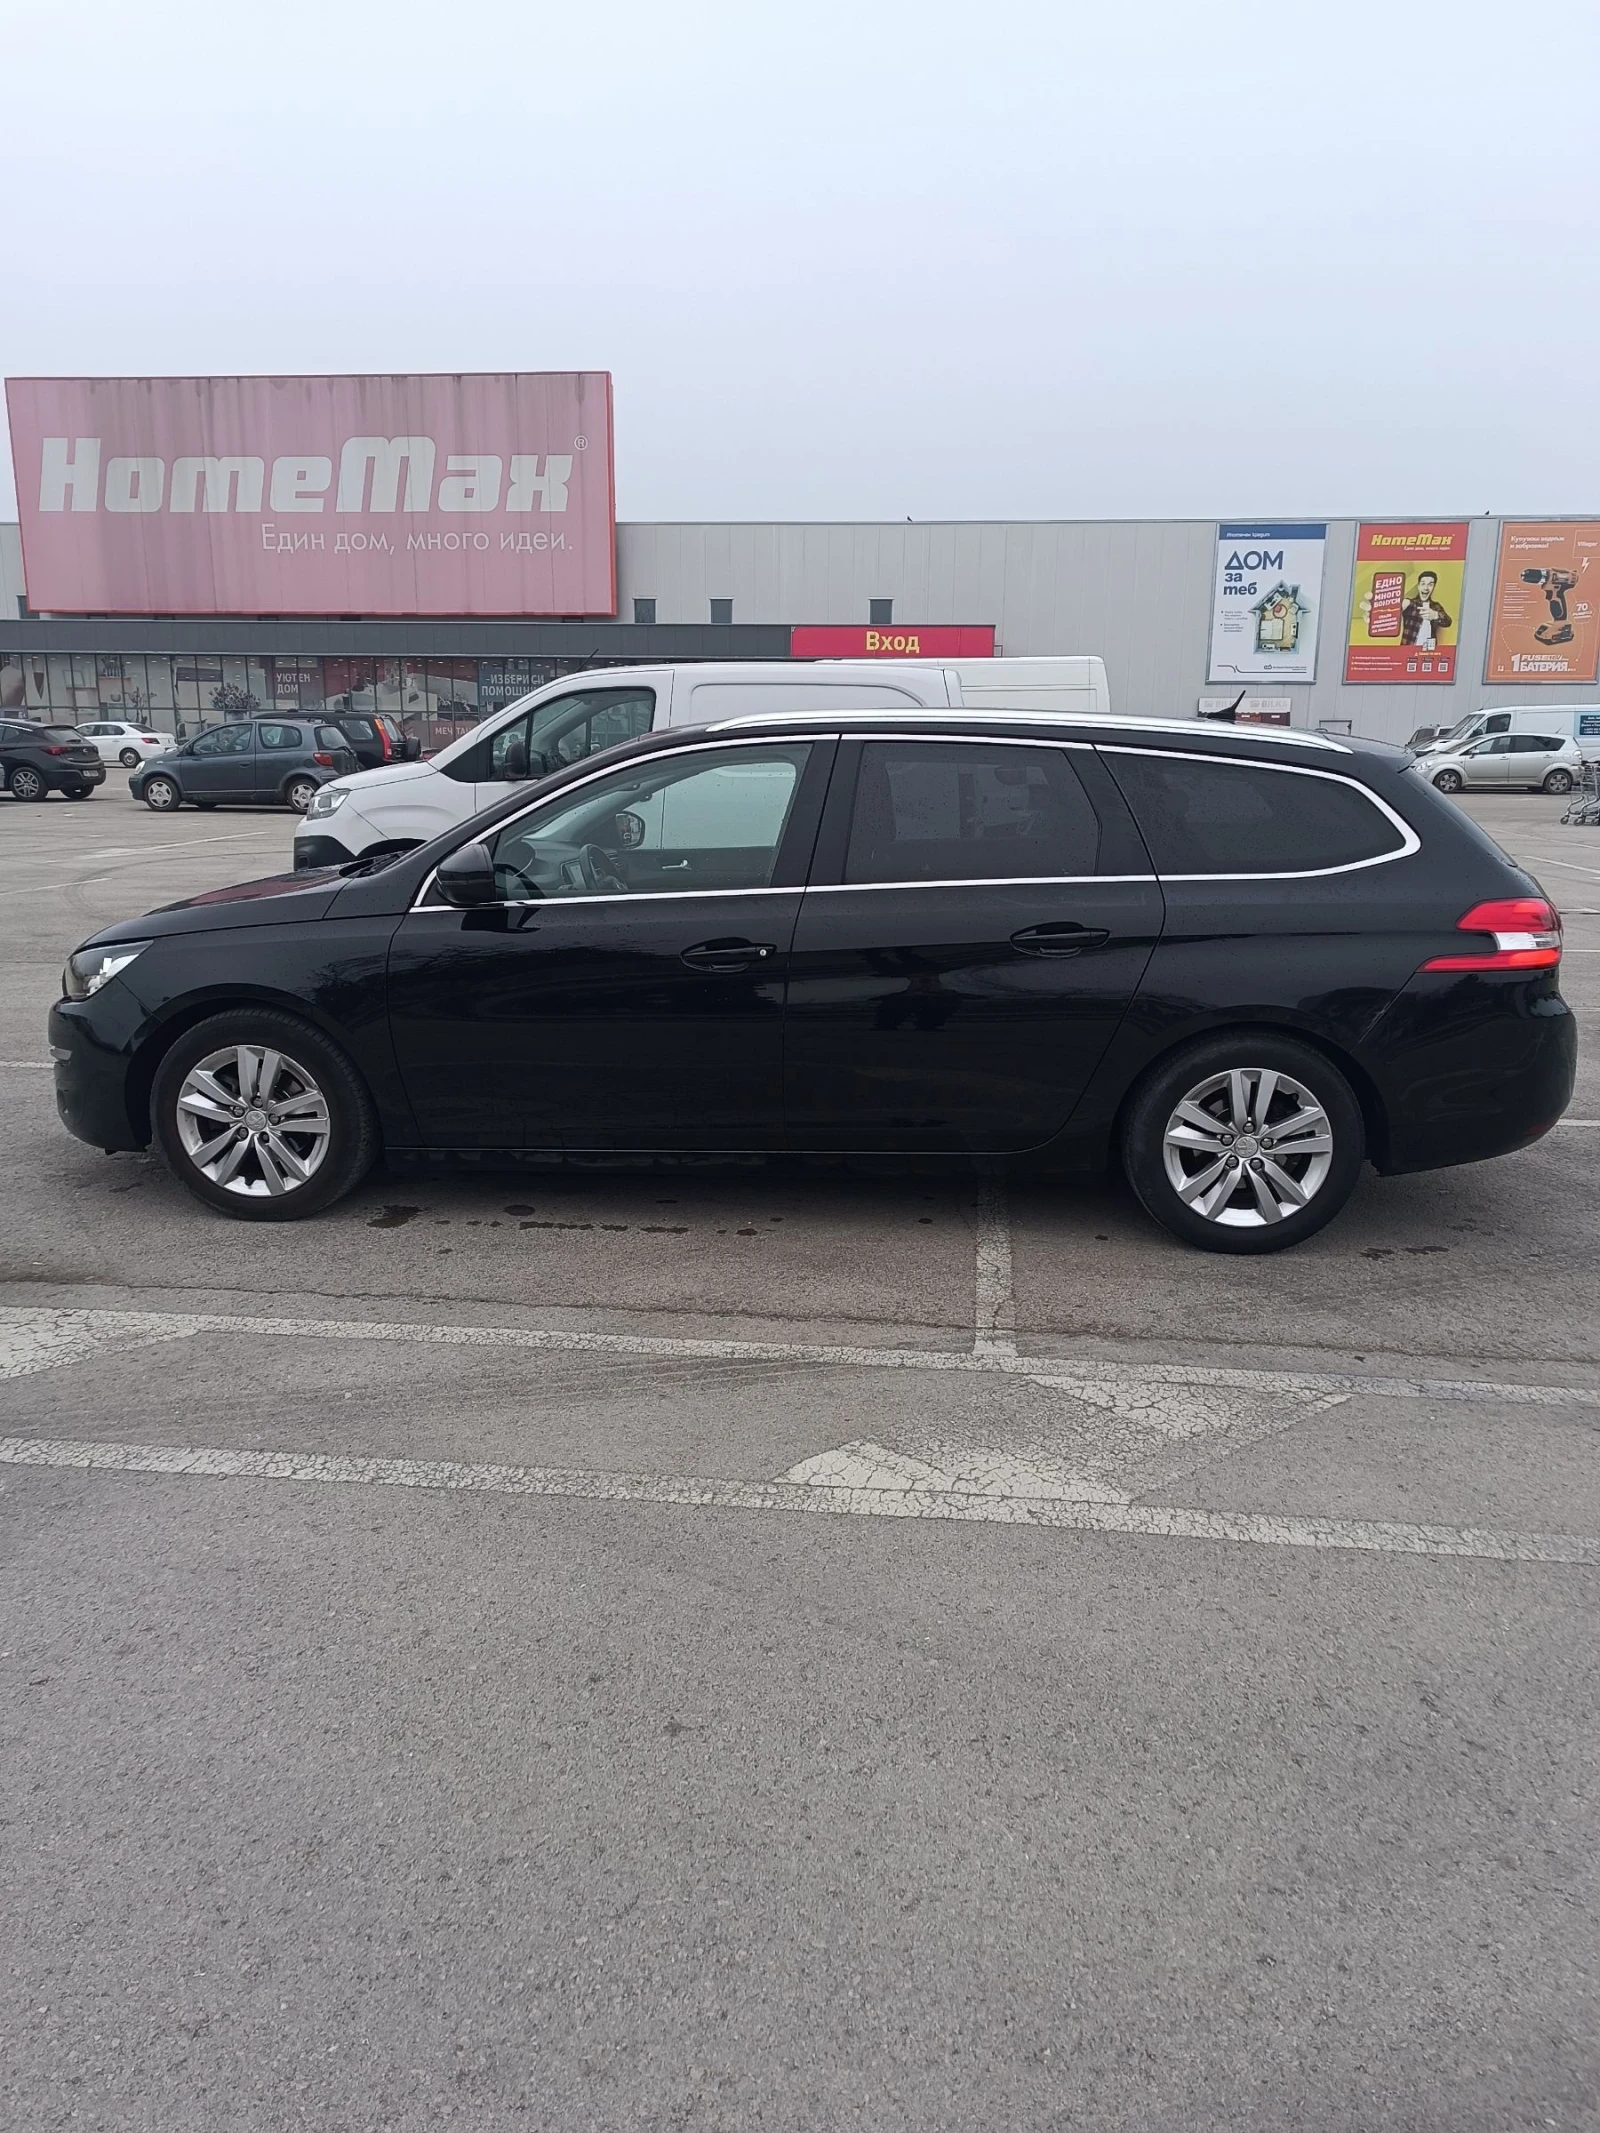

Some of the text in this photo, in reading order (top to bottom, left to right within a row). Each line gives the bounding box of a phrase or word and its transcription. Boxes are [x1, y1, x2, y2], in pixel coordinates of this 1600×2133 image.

[262, 523, 574, 556] Един дом, много идеи.
[1371, 534, 1453, 545] HomeMax
[1224, 550, 1284, 570] ДОМ
[1224, 572, 1243, 582] за
[1375, 576, 1403, 589] ЕДНО
[1223, 582, 1258, 595] теб
[1374, 590, 1401, 601] МНОГО
[1373, 597, 1401, 608] БОНУСИ
[1576, 603, 1588, 611] 70
[866, 631, 920, 653] Вход
[1511, 653, 1521, 672] 1
[276, 673, 311, 683] УЮТЕН
[490, 674, 545, 685] ИЗБЕРИ СИ
[276, 684, 299, 695] ДОМ
[1261, 700, 1288, 708] BILKA
